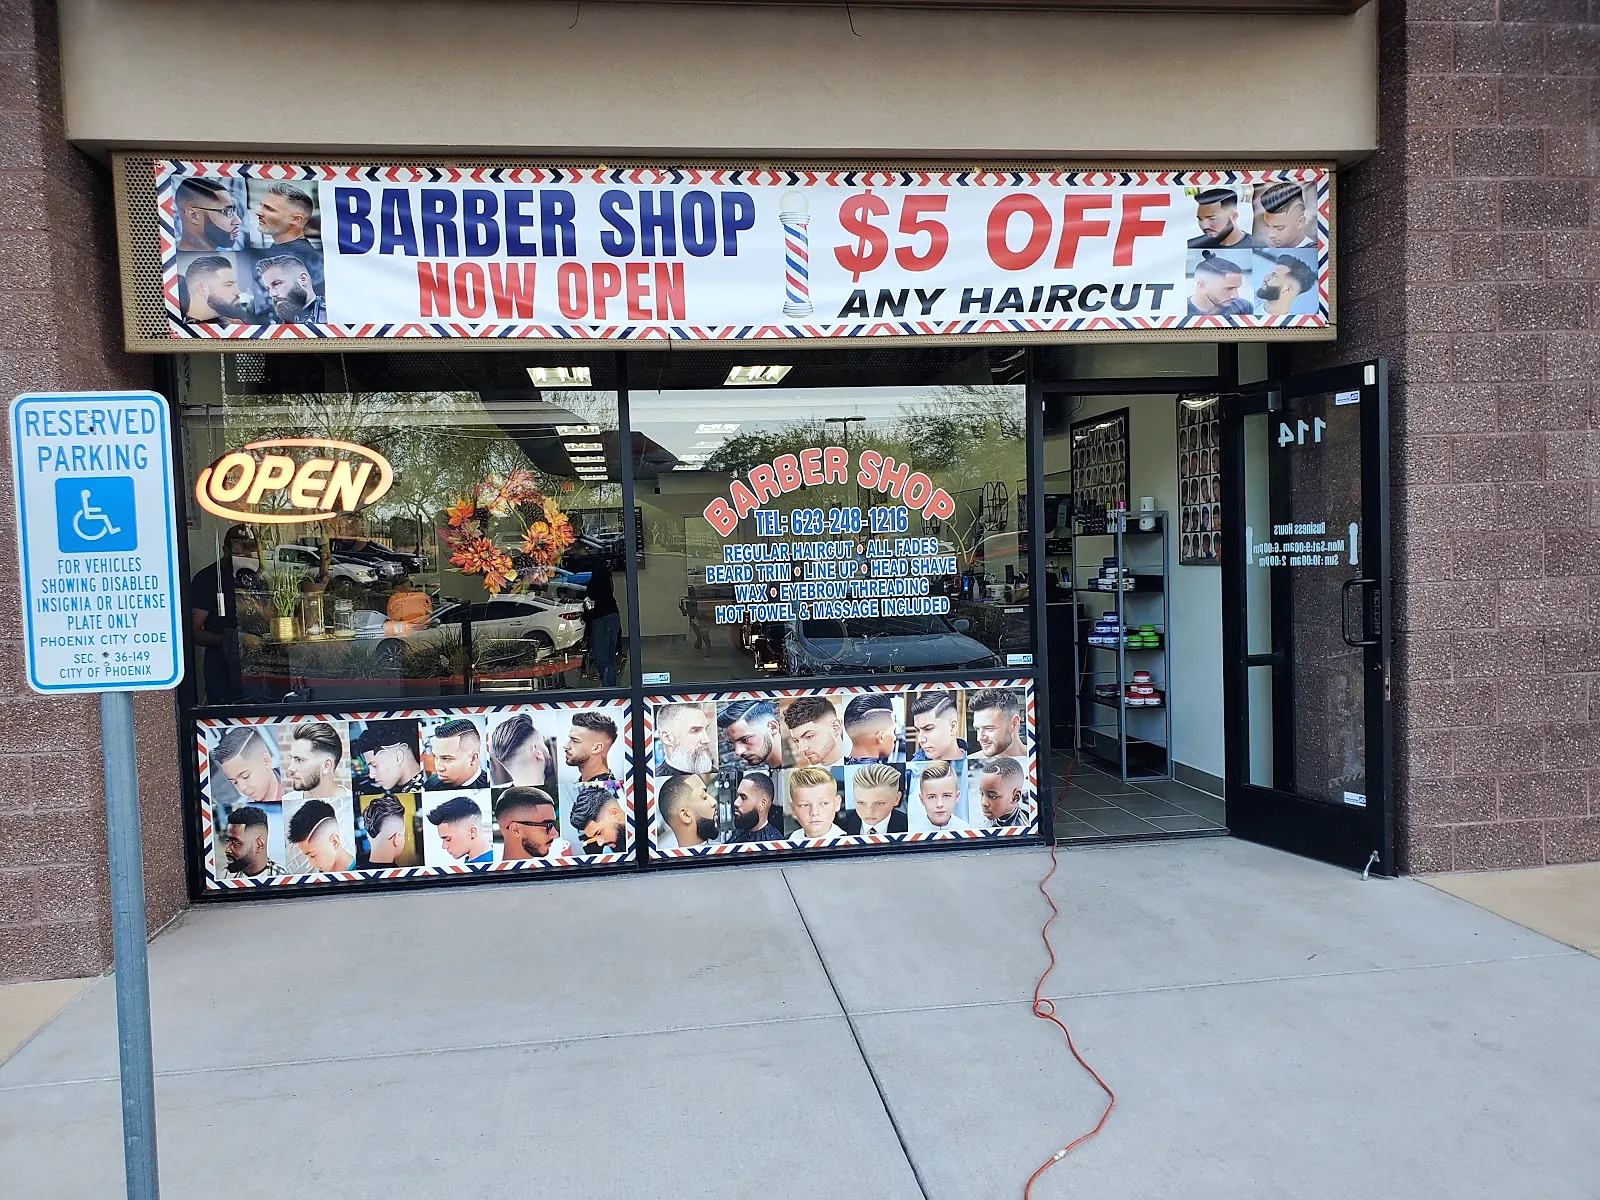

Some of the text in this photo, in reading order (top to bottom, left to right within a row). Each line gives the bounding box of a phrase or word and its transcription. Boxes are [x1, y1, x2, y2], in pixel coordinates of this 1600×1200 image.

[334, 187, 756, 258] BARBER SHOP
[833, 190, 1170, 282] $5 OFF
[416, 261, 686, 320] NOW OPEN
[837, 282, 1174, 319] ANY HAIRCUT
[25, 408, 156, 437] RESERVED
[37, 443, 148, 472] PARKING
[208, 452, 374, 512] OPEN
[704, 446, 956, 537] BARBER SHOP
[754, 506, 908, 536] TEL: 623-248-1216
[723, 537, 938, 563] REGULAR HAIRCUT ALL FADES
[58, 557, 142, 574] FOR VEHICLES
[706, 556, 957, 584] BEARD TRIM LINE UP HEAD SHAVE
[42, 575, 159, 594] SHOWING DISABLED
[735, 578, 929, 603] WAX EYEBROW THREADING
[37, 594, 166, 612] INSIGNIA OR LICENSE
[715, 597, 950, 624] HOT TOWEL & MASSAGE INCLUDED
[68, 613, 138, 630] PLATE ONLY
[40, 632, 167, 648] PHOENIX CITY CODE
[60, 664, 152, 679] CITY OF PHOENIX
[74, 652, 150, 664] SEC. 36-149
